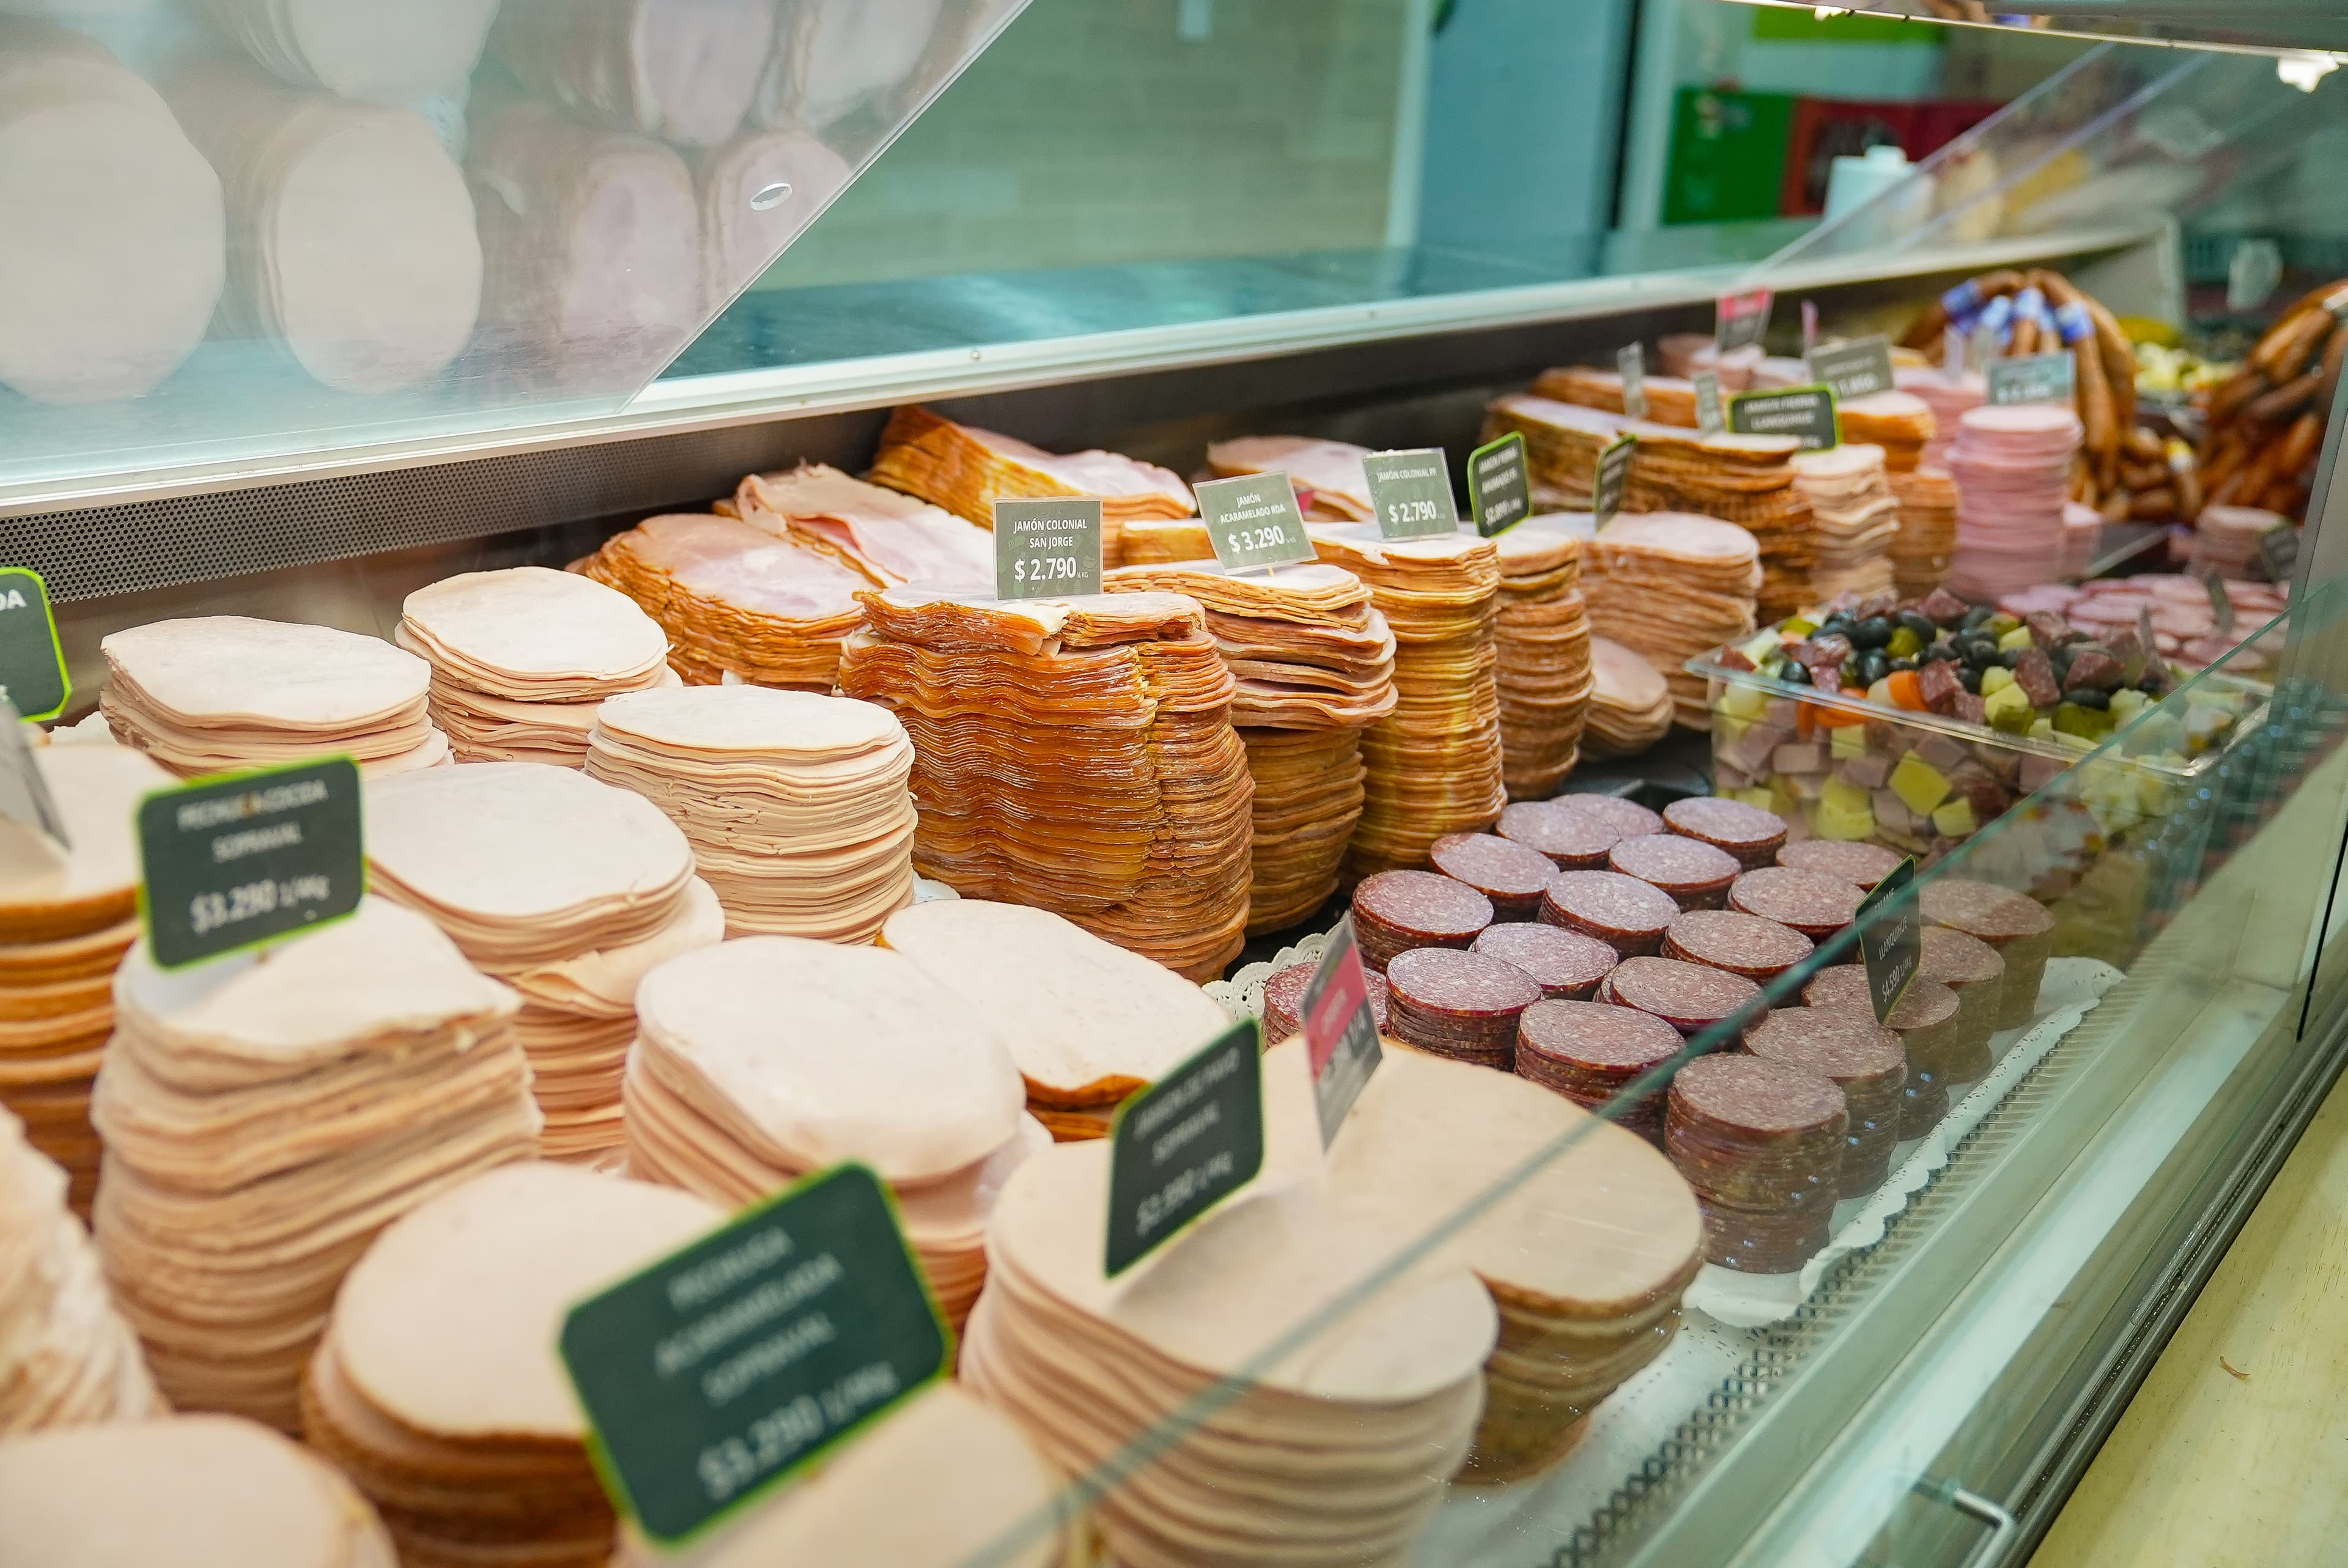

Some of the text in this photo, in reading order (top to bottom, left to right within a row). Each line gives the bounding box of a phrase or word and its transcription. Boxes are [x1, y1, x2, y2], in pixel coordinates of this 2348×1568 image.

[1377, 469, 1400, 483] JAMÓN
[1400, 468, 1430, 479] COLONIAL
[1236, 492, 1261, 509] JAMÓN
[1219, 507, 1271, 525] ACARAMELADO
[1388, 499, 1437, 525] $ 2.790
[1013, 517, 1087, 534] JAMÓN COLONIAL
[1029, 536, 1073, 550] SAN JORGE
[1228, 525, 1284, 554] $ 3.290
[1014, 558, 1025, 583] $
[1030, 556, 1077, 581] 2.790
[1878, 915, 1908, 960] LLANQUIHUE
[1881, 965, 1900, 1004] $4.590
